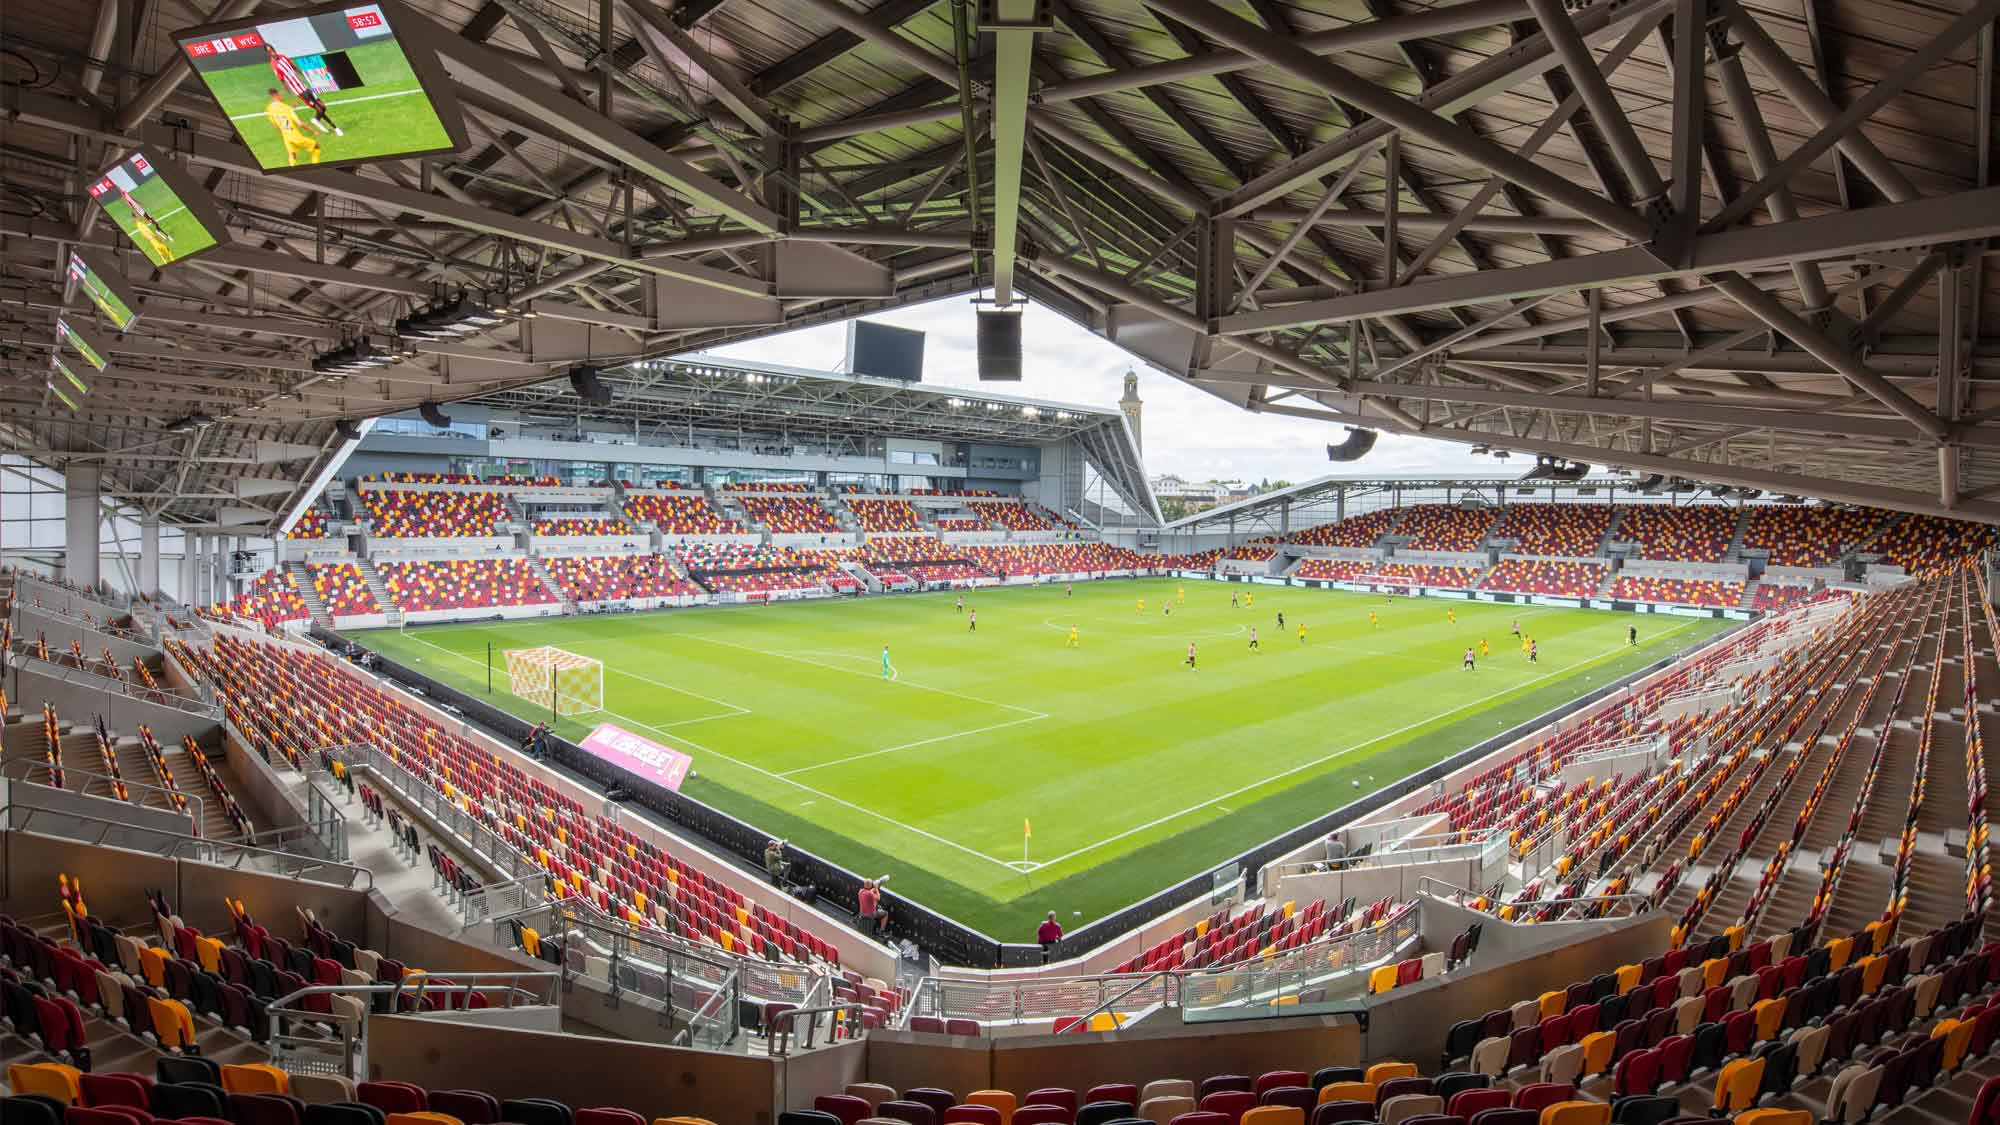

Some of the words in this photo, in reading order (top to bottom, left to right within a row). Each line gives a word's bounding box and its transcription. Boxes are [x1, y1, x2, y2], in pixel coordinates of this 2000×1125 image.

[352, 15, 377, 27] 58:52
[194, 44, 212, 55] BRE
[238, 36, 257, 46] WYC
